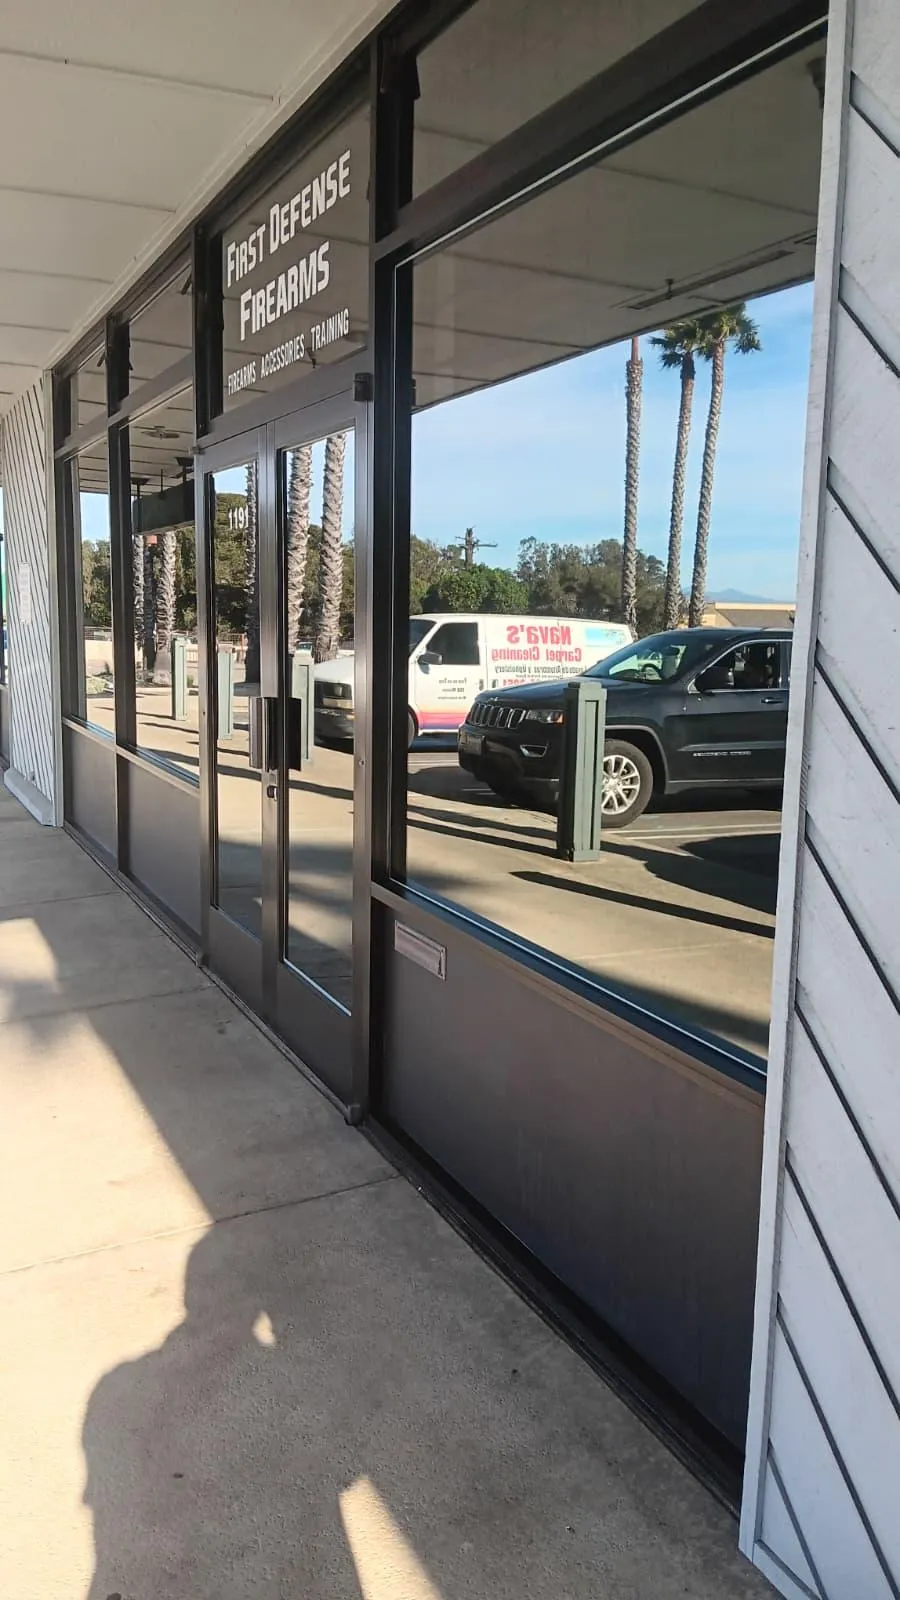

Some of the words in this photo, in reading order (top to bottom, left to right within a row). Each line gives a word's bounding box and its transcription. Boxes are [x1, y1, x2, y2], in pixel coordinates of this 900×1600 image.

[227, 223, 266, 288] FIRST
[269, 149, 351, 254] DEFENSE
[240, 241, 330, 341] FIREARMS
[228, 361, 257, 396] FIREARMS
[260, 333, 305, 379] ACCESSORIES
[310, 308, 350, 352] TRAINING
[228, 503, 249, 530] 1191
